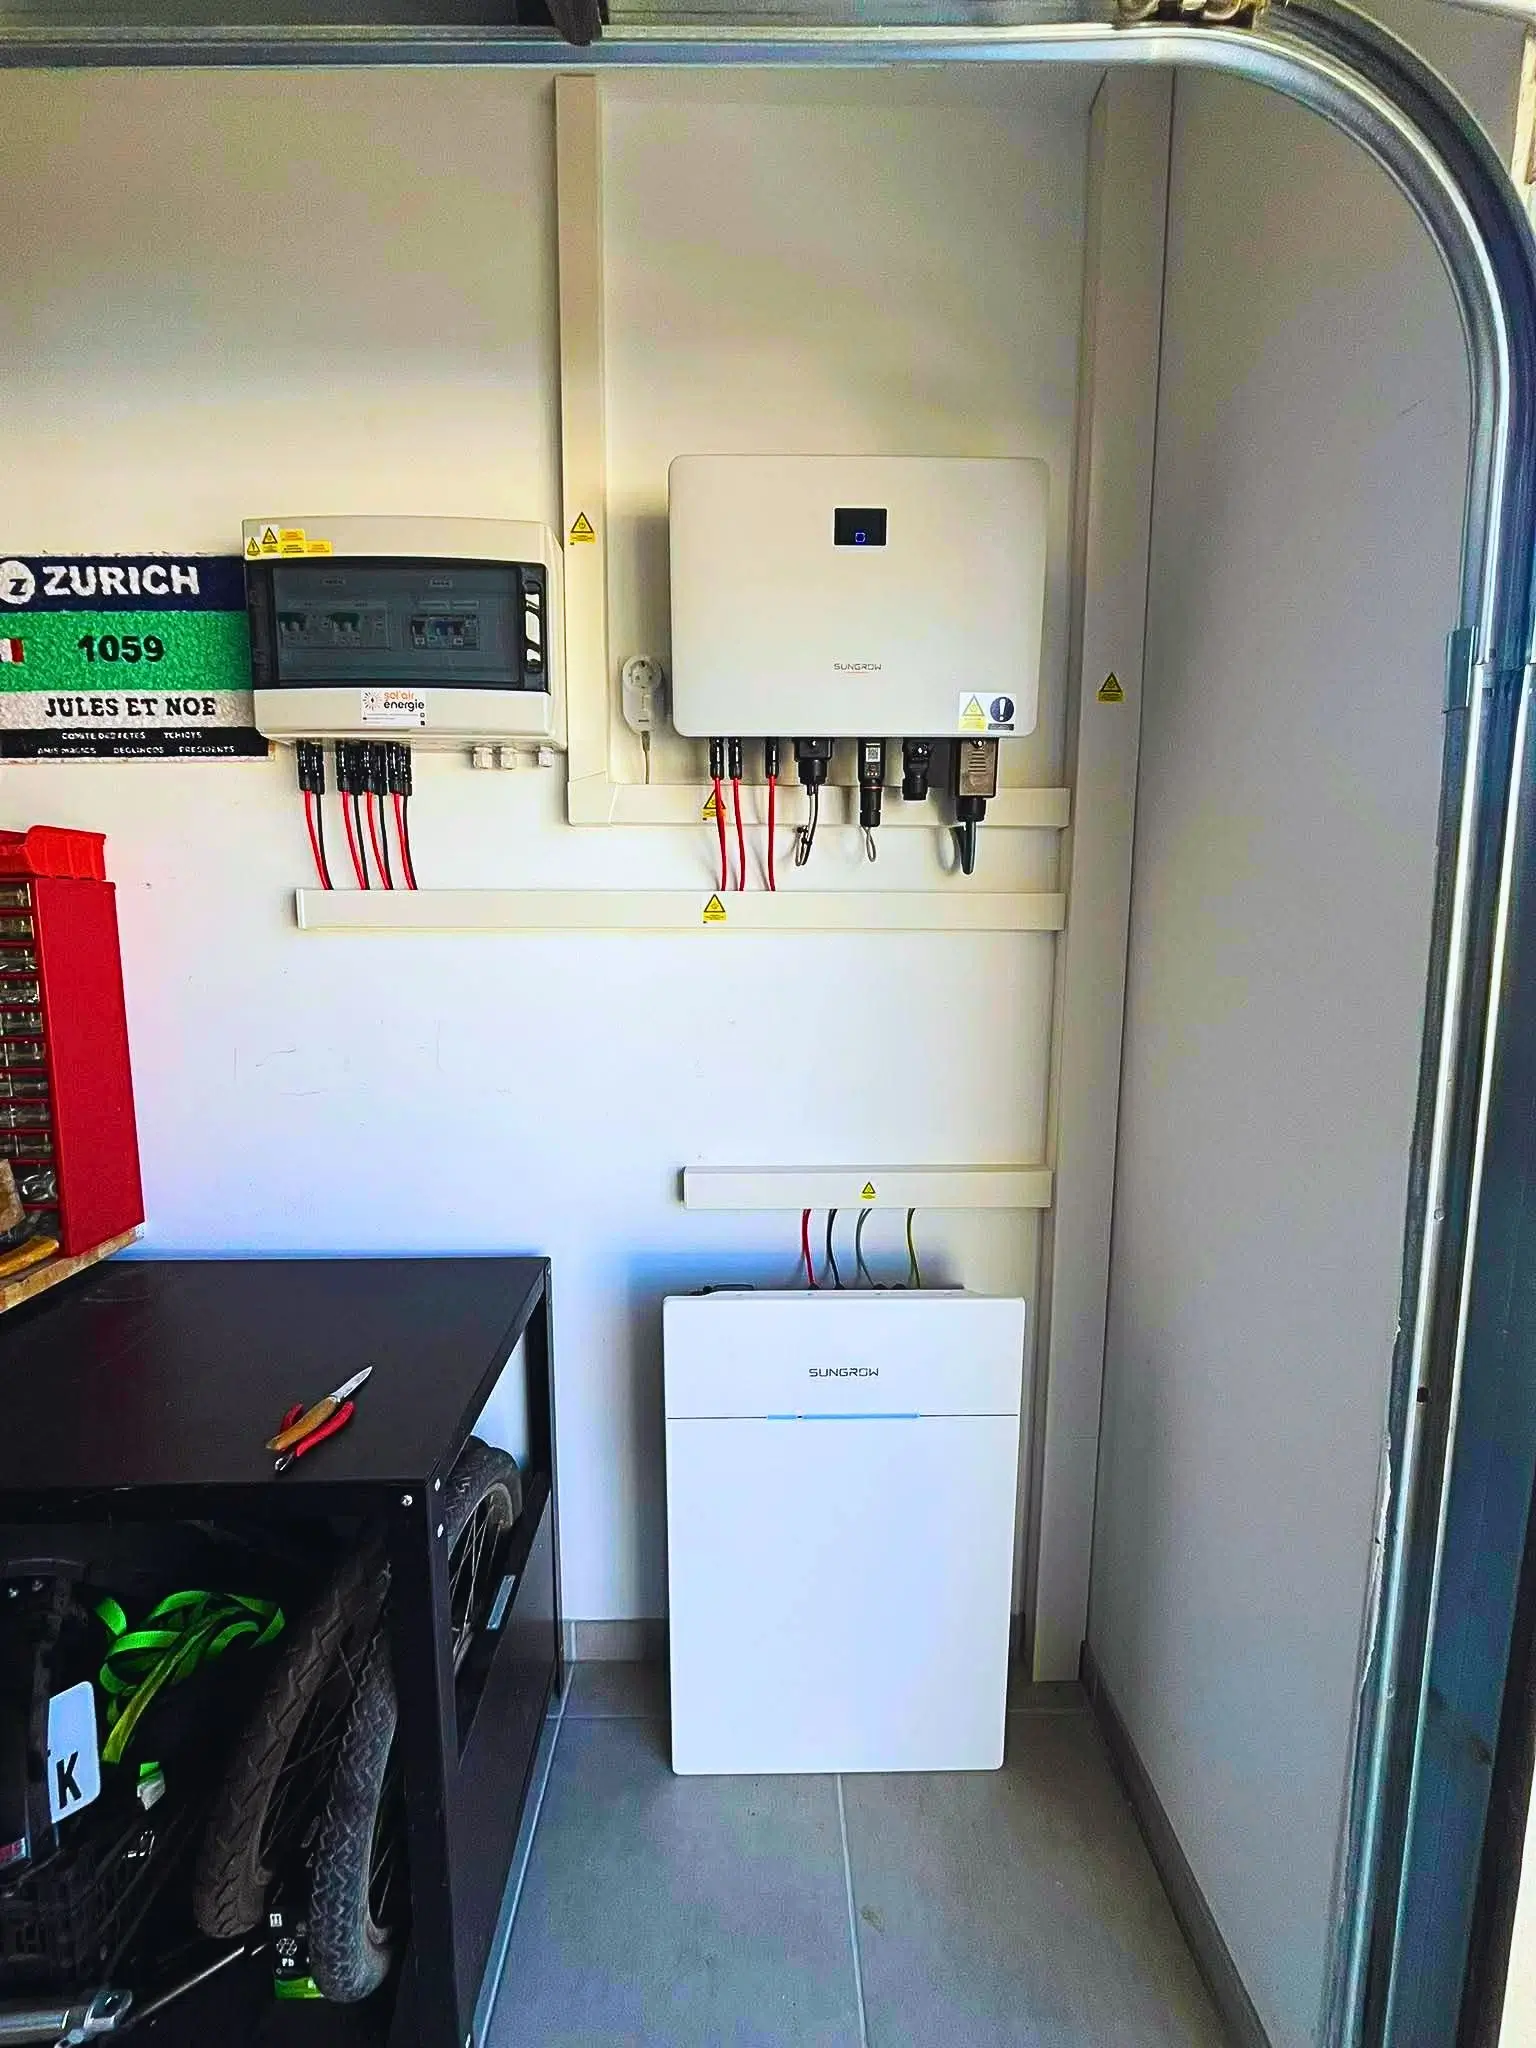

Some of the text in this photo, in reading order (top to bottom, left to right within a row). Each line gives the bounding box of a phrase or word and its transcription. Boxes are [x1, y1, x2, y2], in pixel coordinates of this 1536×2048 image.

[42, 565, 200, 596] ZURICH
[78, 634, 164, 663] 1059
[833, 663, 882, 671] SUNGROW
[45, 697, 217, 717] JULES ET NOE
[808, 1367, 879, 1378] SUNGROW
